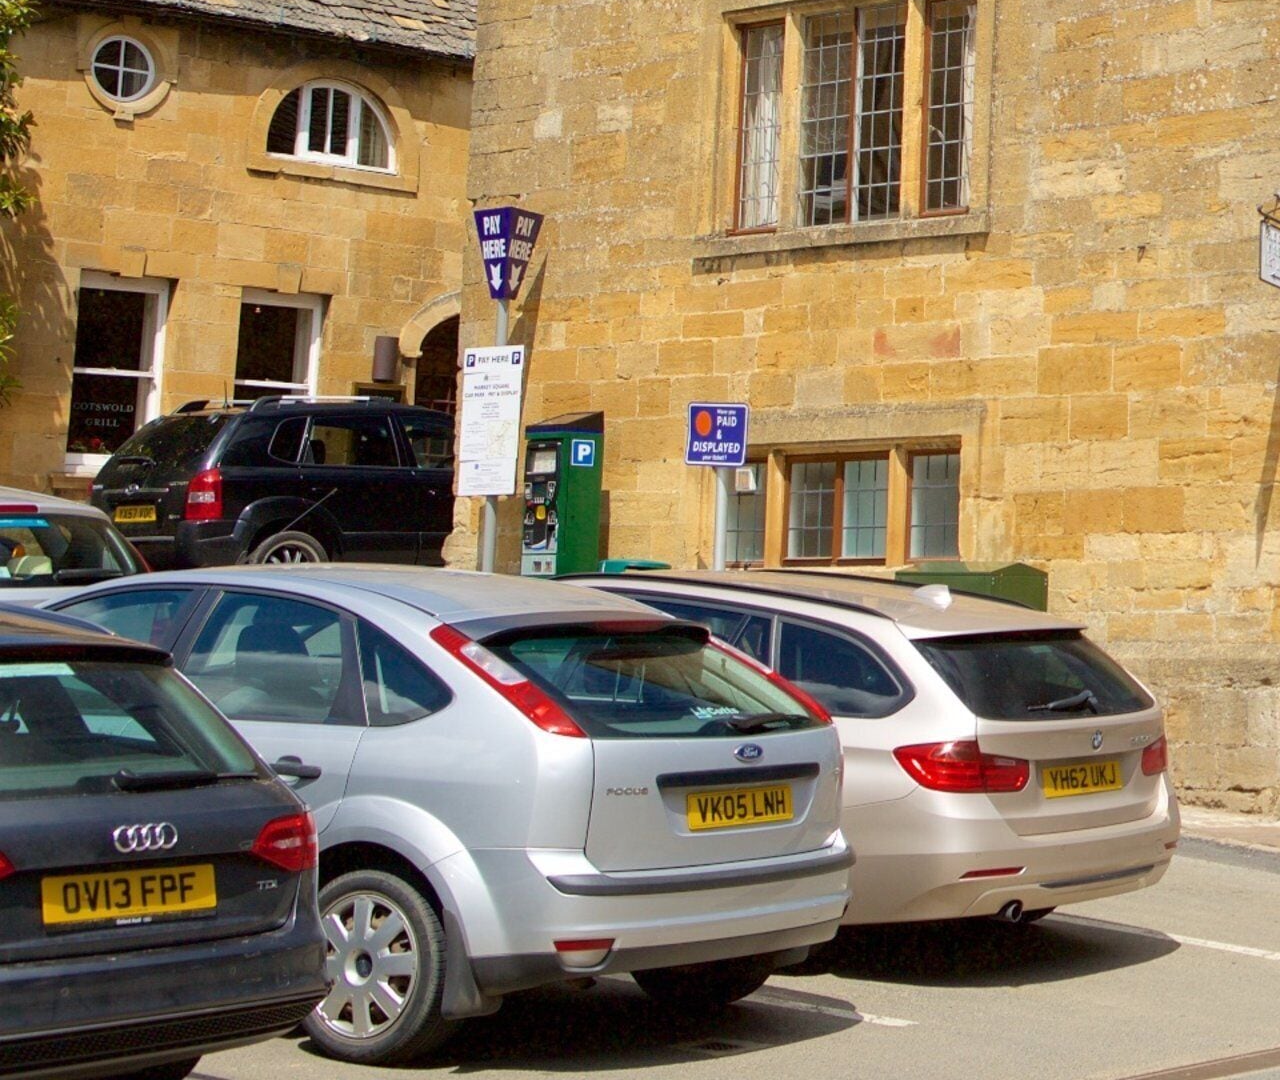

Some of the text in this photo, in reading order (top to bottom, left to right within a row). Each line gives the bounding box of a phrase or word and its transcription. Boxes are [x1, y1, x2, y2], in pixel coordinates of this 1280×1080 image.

[483, 215, 501, 235] PAY
[515, 216, 535, 237] PAY
[482, 239, 506, 260] HERE
[508, 239, 533, 261] HERE
[73, 402, 134, 413] COTSWOLD
[85, 418, 120, 427] GRILL
[717, 416, 737, 427] PAID
[693, 441, 741, 453] DISPLAYED
[1050, 764, 1116, 791] YH62 UKJ
[606, 787, 649, 796] FOCUS
[697, 790, 786, 822] VK05 LNH
[62, 872, 196, 913] OV13 FPF
[257, 879, 278, 890] TDI
